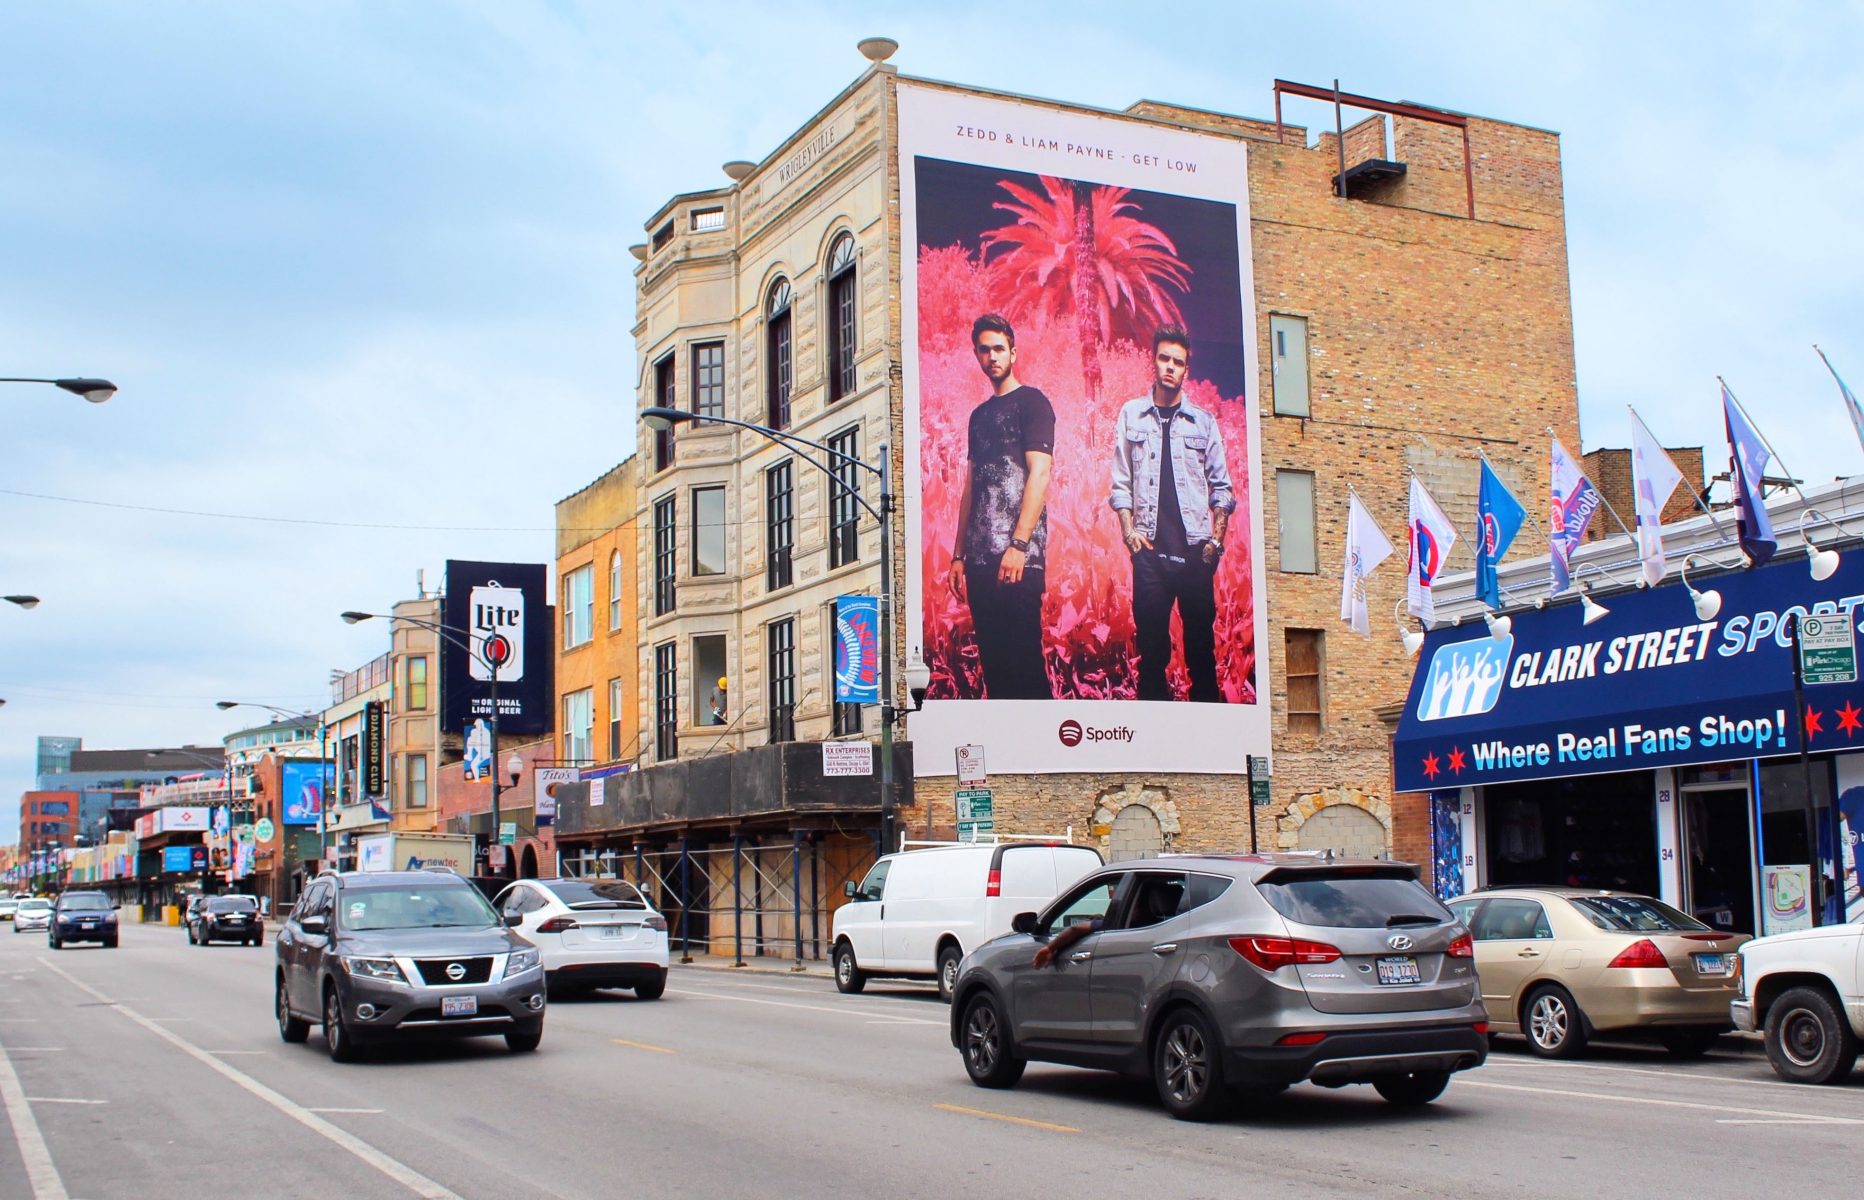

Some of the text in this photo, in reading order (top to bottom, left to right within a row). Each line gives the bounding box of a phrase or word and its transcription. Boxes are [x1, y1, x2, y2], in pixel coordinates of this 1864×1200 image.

[779, 126, 836, 184] WRIGLEYVILLE
[956, 126, 998, 142] ZEDD
[1005, 133, 1014, 144] &
[1022, 135, 1059, 152] LIAM
[1067, 143, 1114, 160] PAYNE
[1132, 154, 1159, 168] GET
[1166, 159, 1198, 174] LOW
[475, 604, 520, 632] Lite
[1510, 595, 1864, 689] CLARK STREET SPOT
[481, 698, 521, 707] ORINAL
[472, 706, 521, 715] LIGH BEER
[371, 714, 379, 763] DIAMOND
[1086, 726, 1134, 743] Spotify
[1472, 709, 1786, 771] Where Real Fans Shop!
[371, 766, 379, 792] CLUB
[543, 770, 571, 780] Tito's
[1659, 789, 1670, 802] 28
[1463, 803, 1471, 815] 12
[1465, 855, 1474, 866] 18
[1662, 848, 1673, 861] 34
[427, 858, 458, 868] newtec
